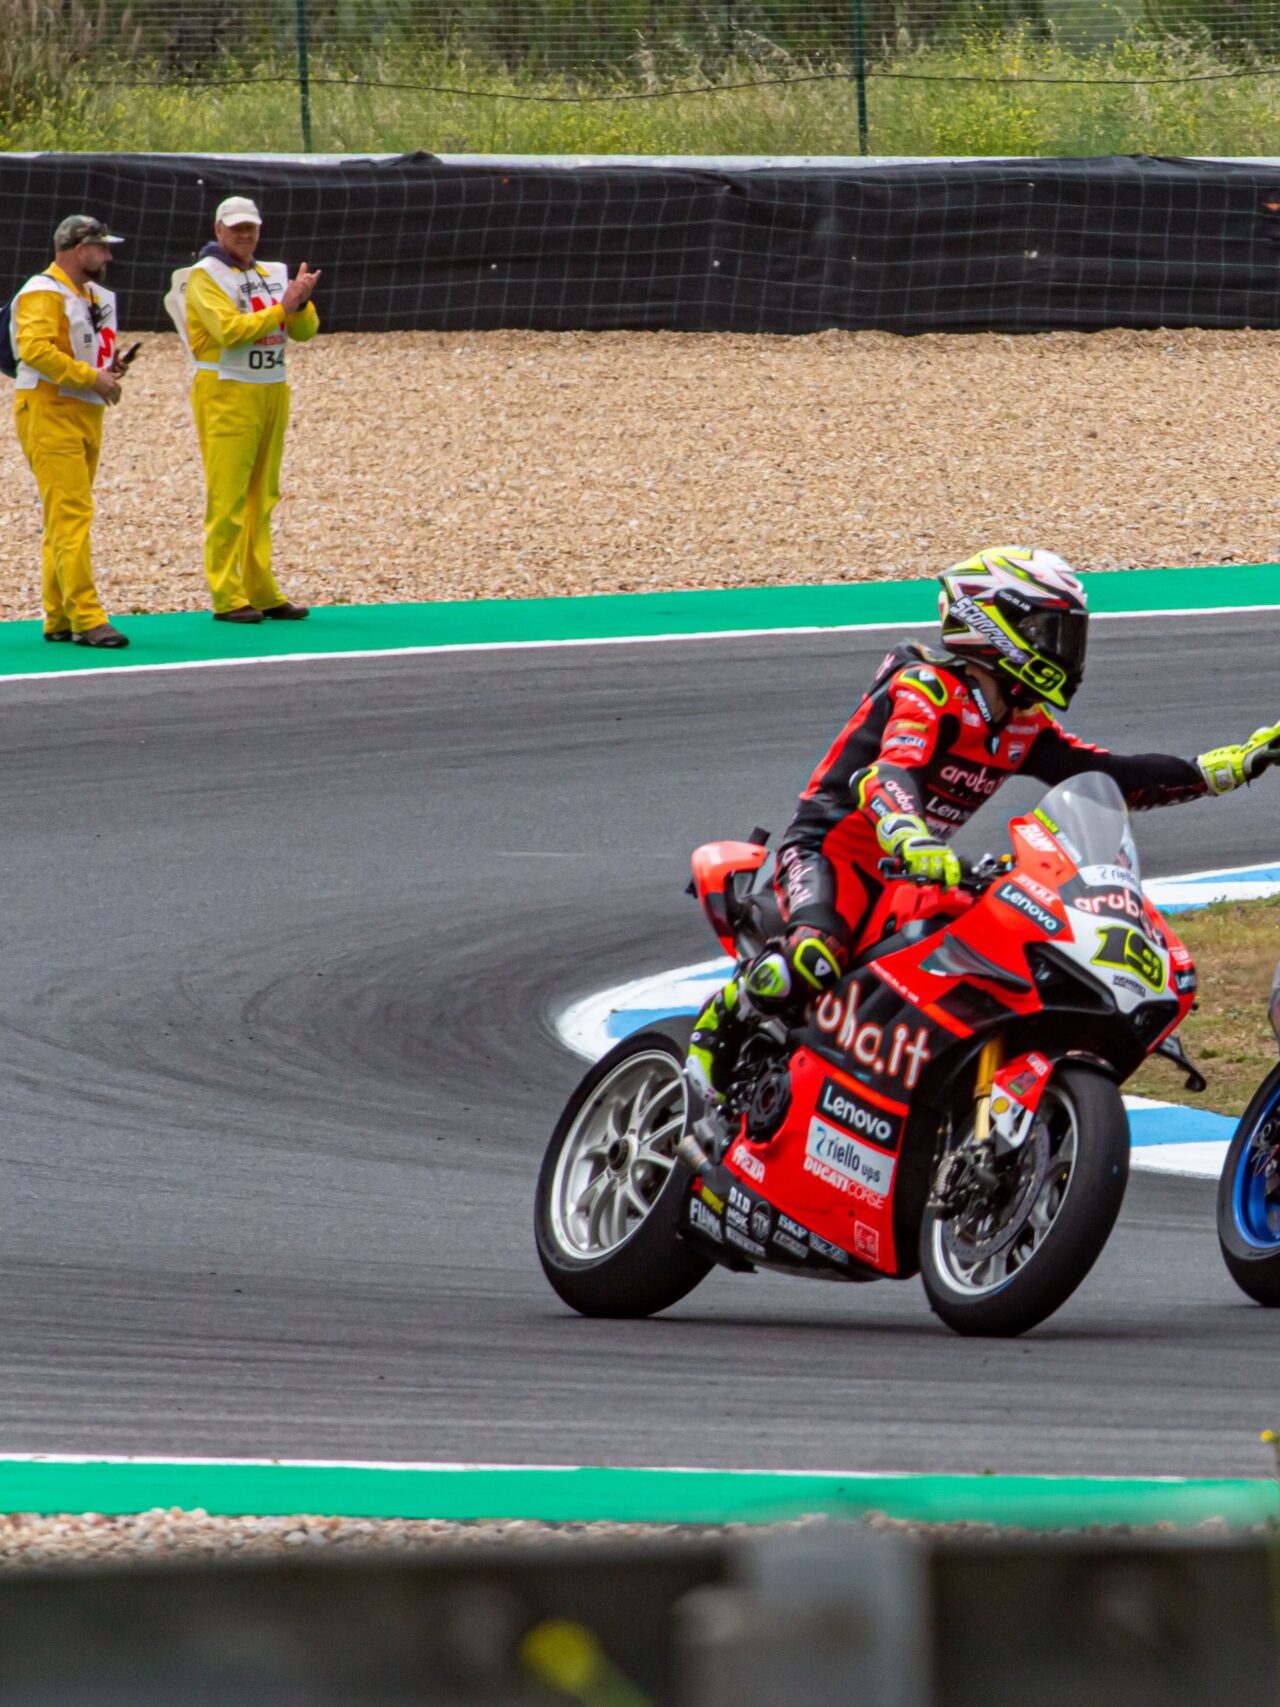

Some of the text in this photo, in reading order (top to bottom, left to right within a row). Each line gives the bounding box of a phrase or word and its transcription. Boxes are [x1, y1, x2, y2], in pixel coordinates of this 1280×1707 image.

[1000, 885, 1058, 930] Lenovo
[816, 981, 930, 1088] uba.it
[822, 1085, 892, 1140] Lenovo
[827, 1136, 882, 1183] riello ups
